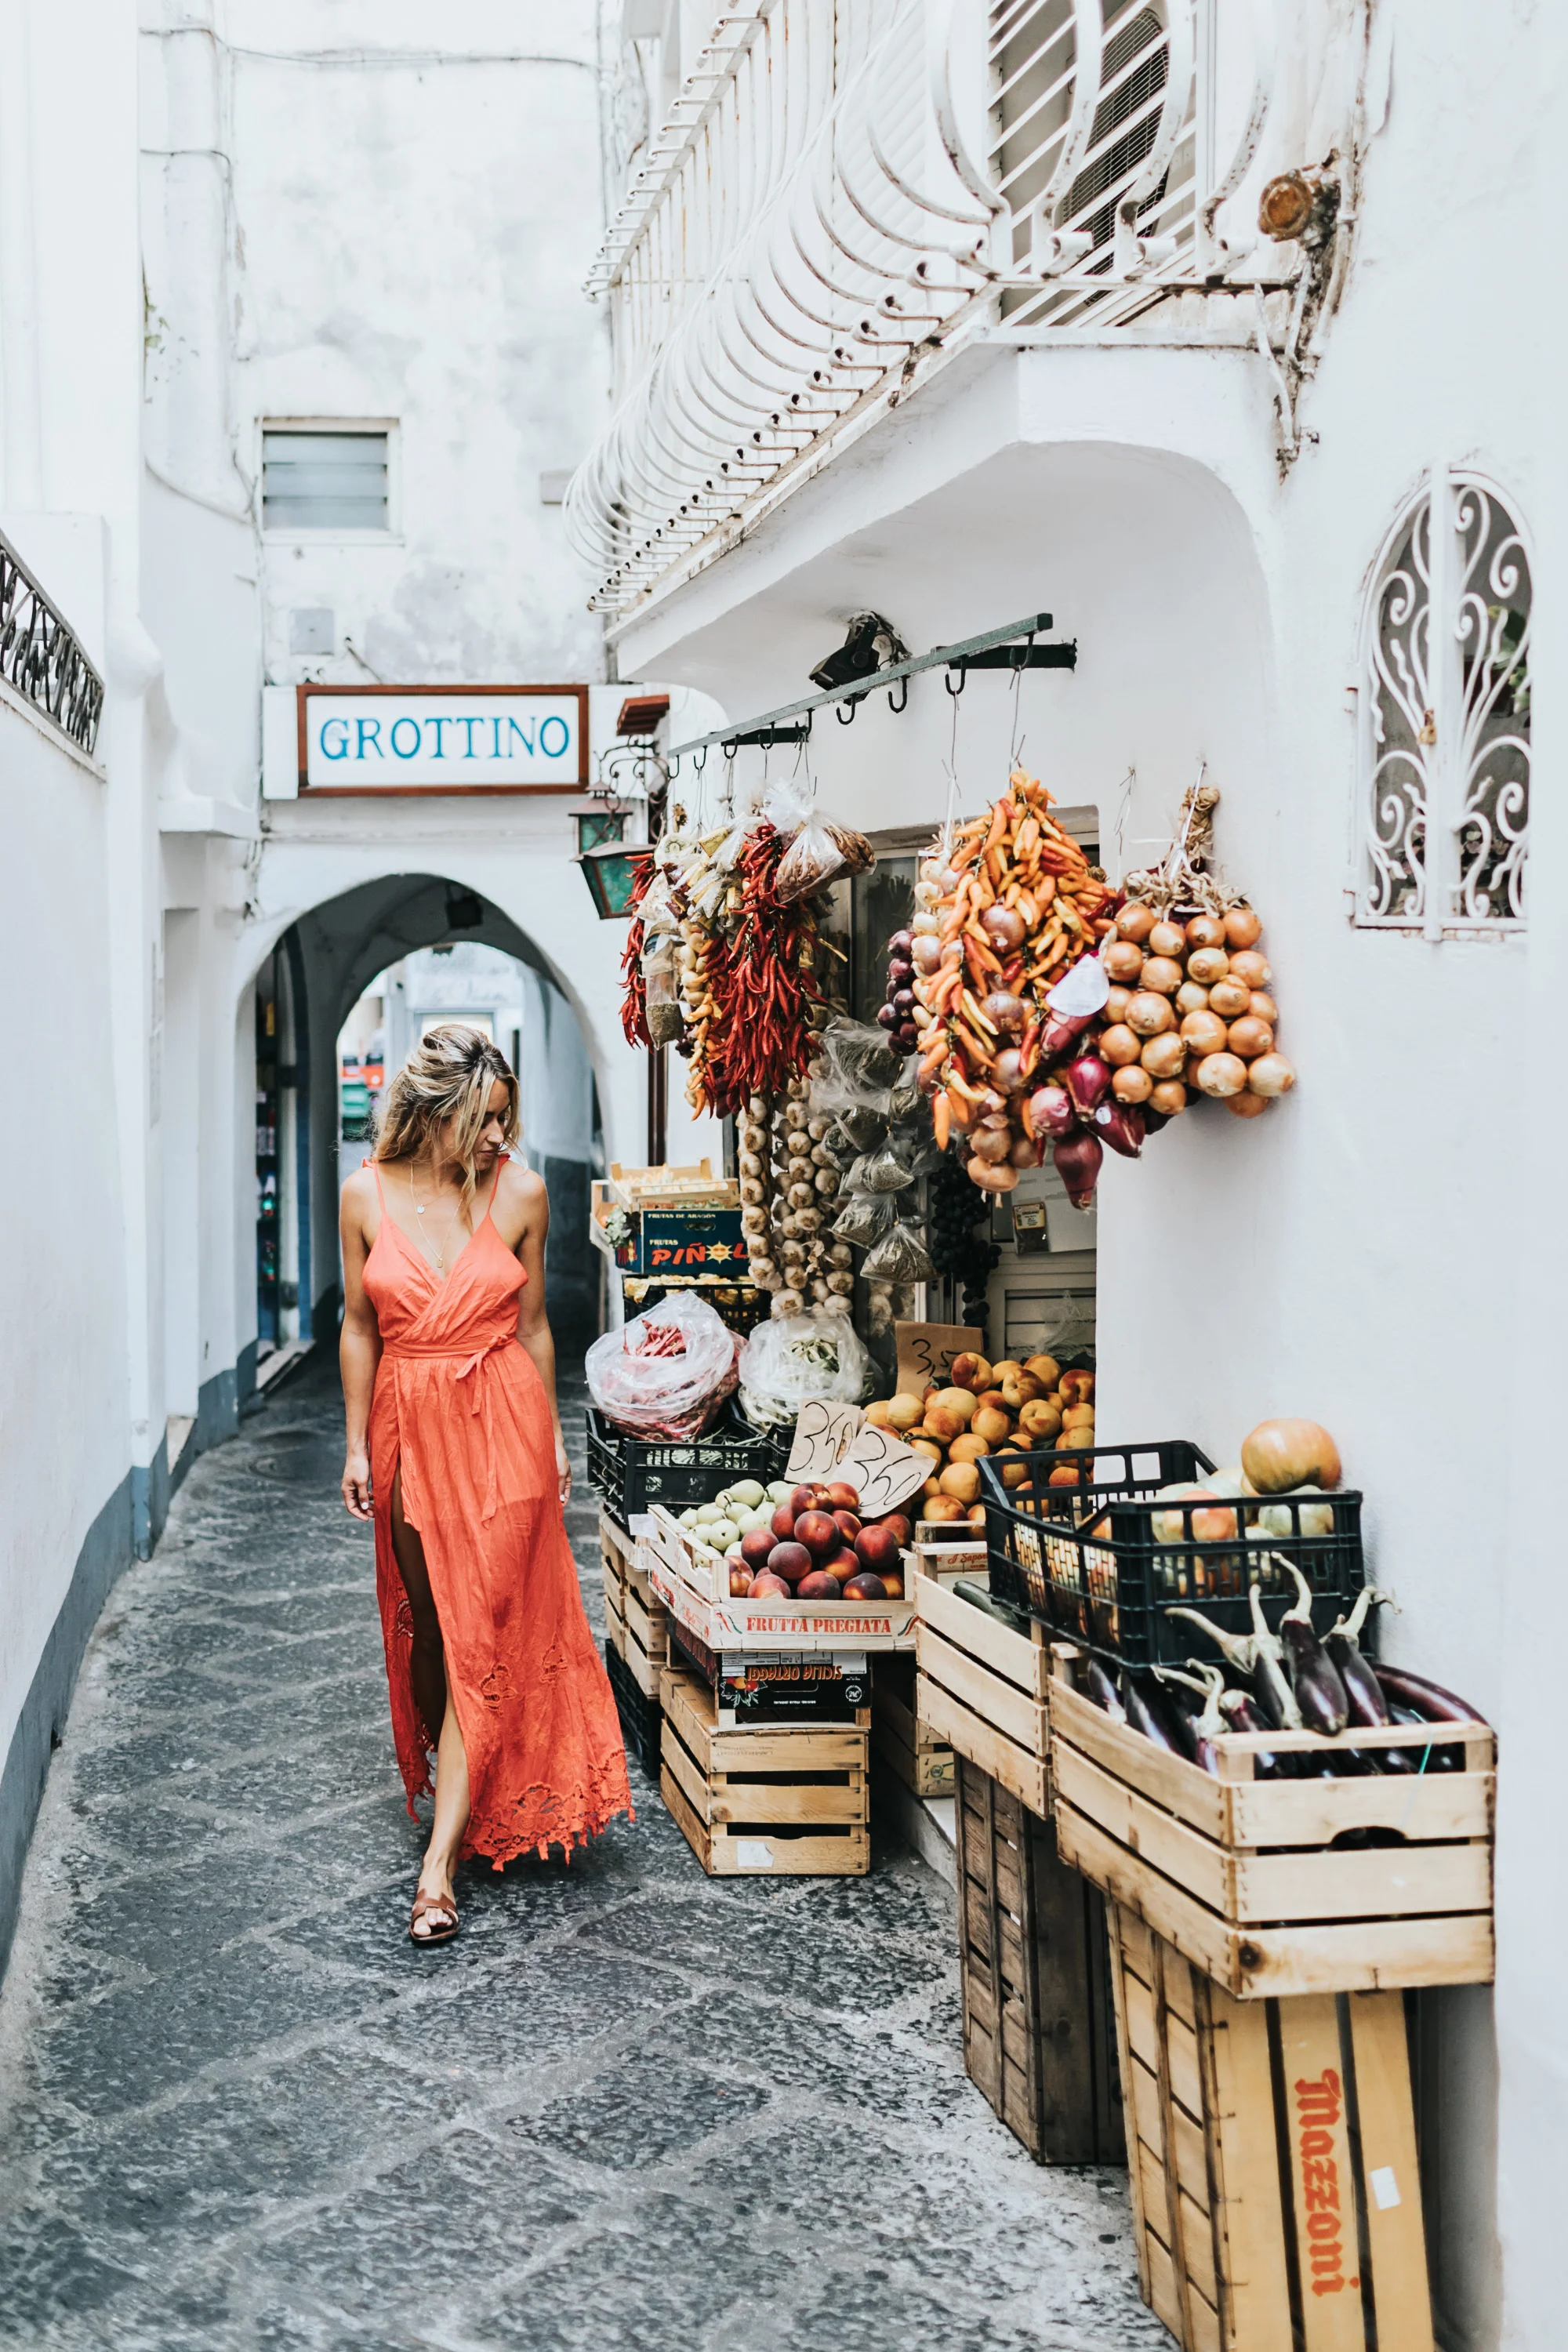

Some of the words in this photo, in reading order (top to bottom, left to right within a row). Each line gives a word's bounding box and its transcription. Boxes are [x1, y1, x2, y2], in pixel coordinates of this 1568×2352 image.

[319, 716, 570, 760] GROTTINO
[746, 1617, 809, 1634] FRUTTA
[813, 1615, 892, 1633] PREGIATA
[747, 1665, 800, 1682] ORTAGGI
[803, 1664, 843, 1680] SICILIA
[1294, 2068, 1360, 2297] Mazzoni
